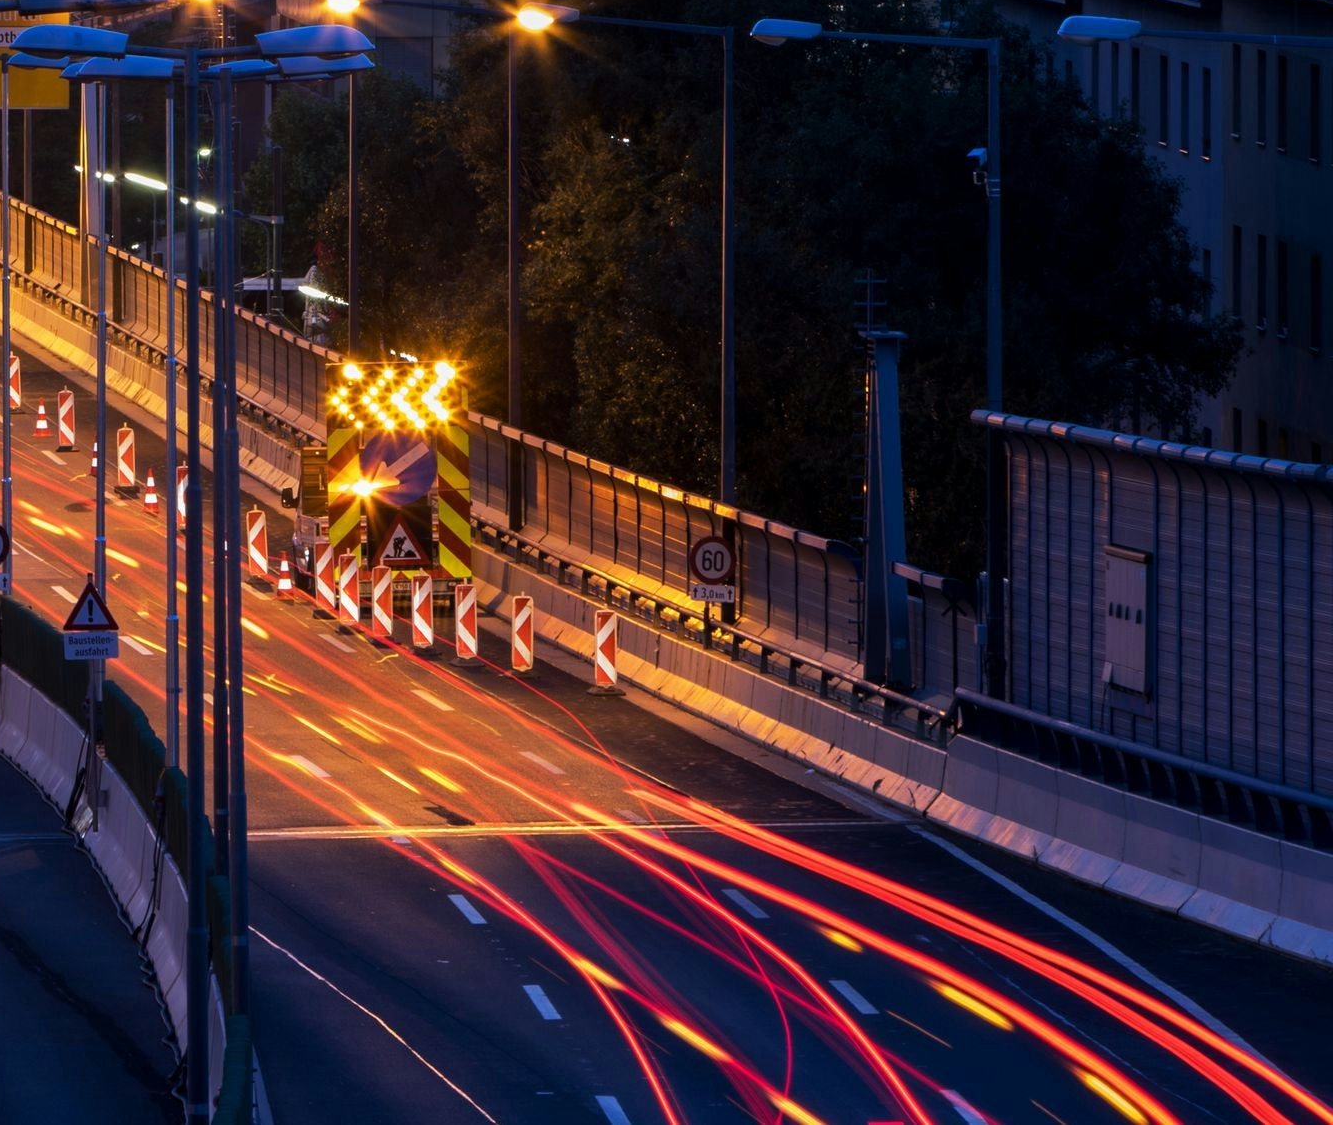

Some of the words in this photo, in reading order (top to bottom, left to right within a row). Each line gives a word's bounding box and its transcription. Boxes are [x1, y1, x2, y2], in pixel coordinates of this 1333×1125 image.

[702, 550, 724, 572] 60
[701, 587, 714, 600] 3,0
[715, 590, 725, 599] km
[68, 637, 114, 645] Baustellen-
[74, 647, 109, 658] ausfahrt
